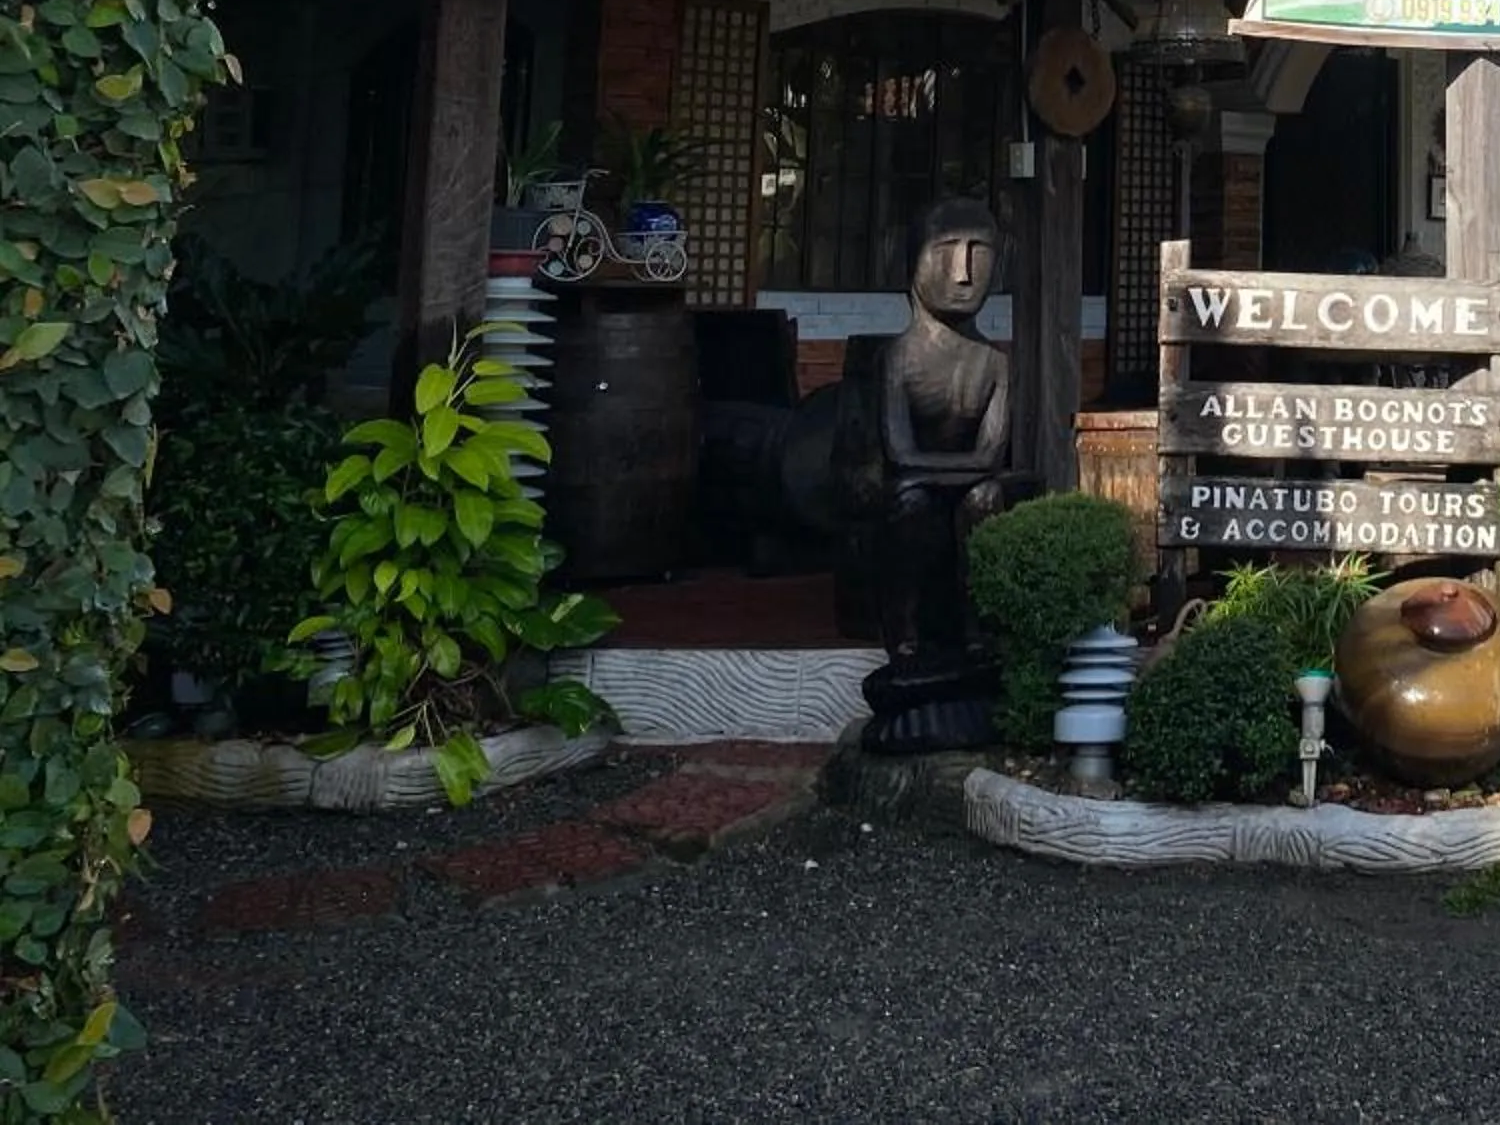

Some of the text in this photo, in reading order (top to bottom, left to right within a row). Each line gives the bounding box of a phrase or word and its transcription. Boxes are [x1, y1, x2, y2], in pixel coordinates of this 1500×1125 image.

[1187, 287, 1489, 336] WELCOME
[1200, 394, 1318, 420] ALLAN
[1221, 424, 1455, 454] GUESTHOUSE
[1191, 485, 1486, 518] PINATUBO TOURS
[1180, 516, 1497, 550] & ACCOMMODATION
